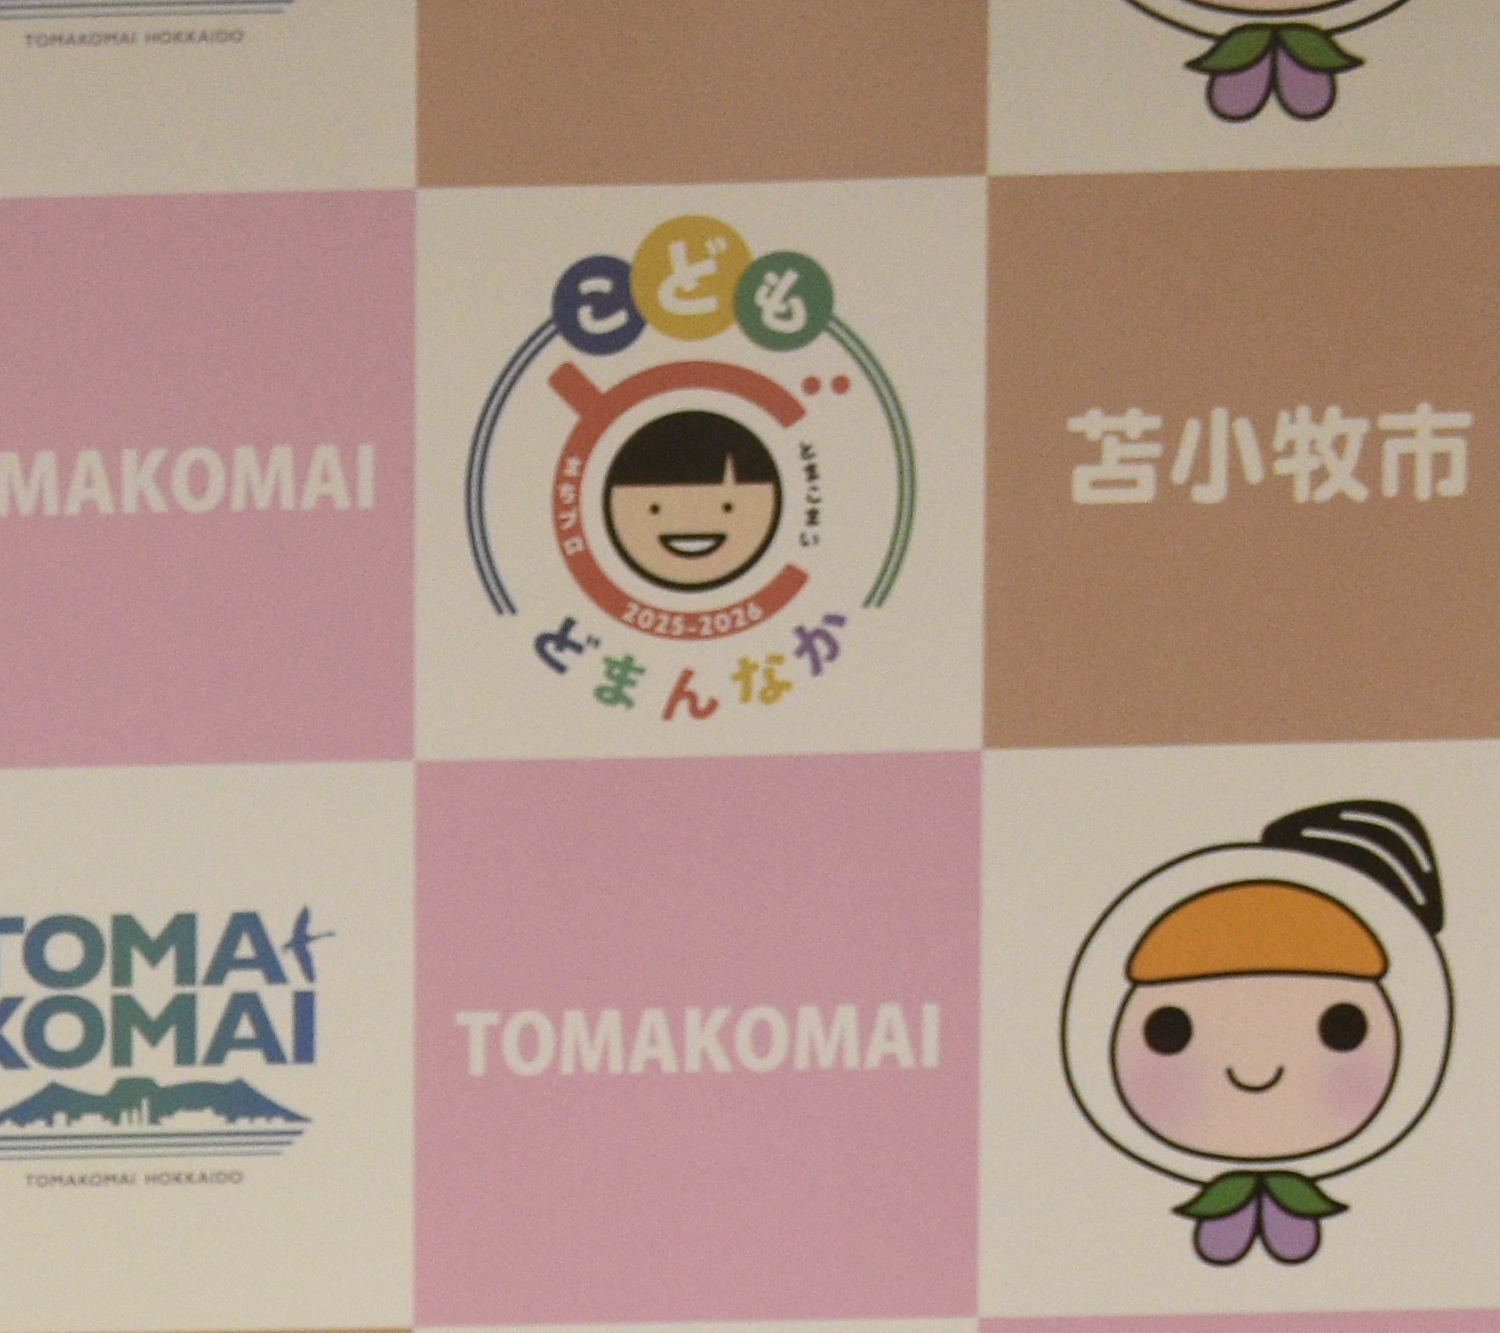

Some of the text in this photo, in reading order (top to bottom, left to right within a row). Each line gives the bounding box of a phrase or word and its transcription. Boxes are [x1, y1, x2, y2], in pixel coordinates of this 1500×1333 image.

[577, 236, 809, 333] こども
[1067, 402, 1473, 504] 苫小牧市
[621, 599, 764, 637] 2025-2026
[532, 613, 845, 721] どまんなか
[455, 1002, 940, 1077] TOMAKOMAI
